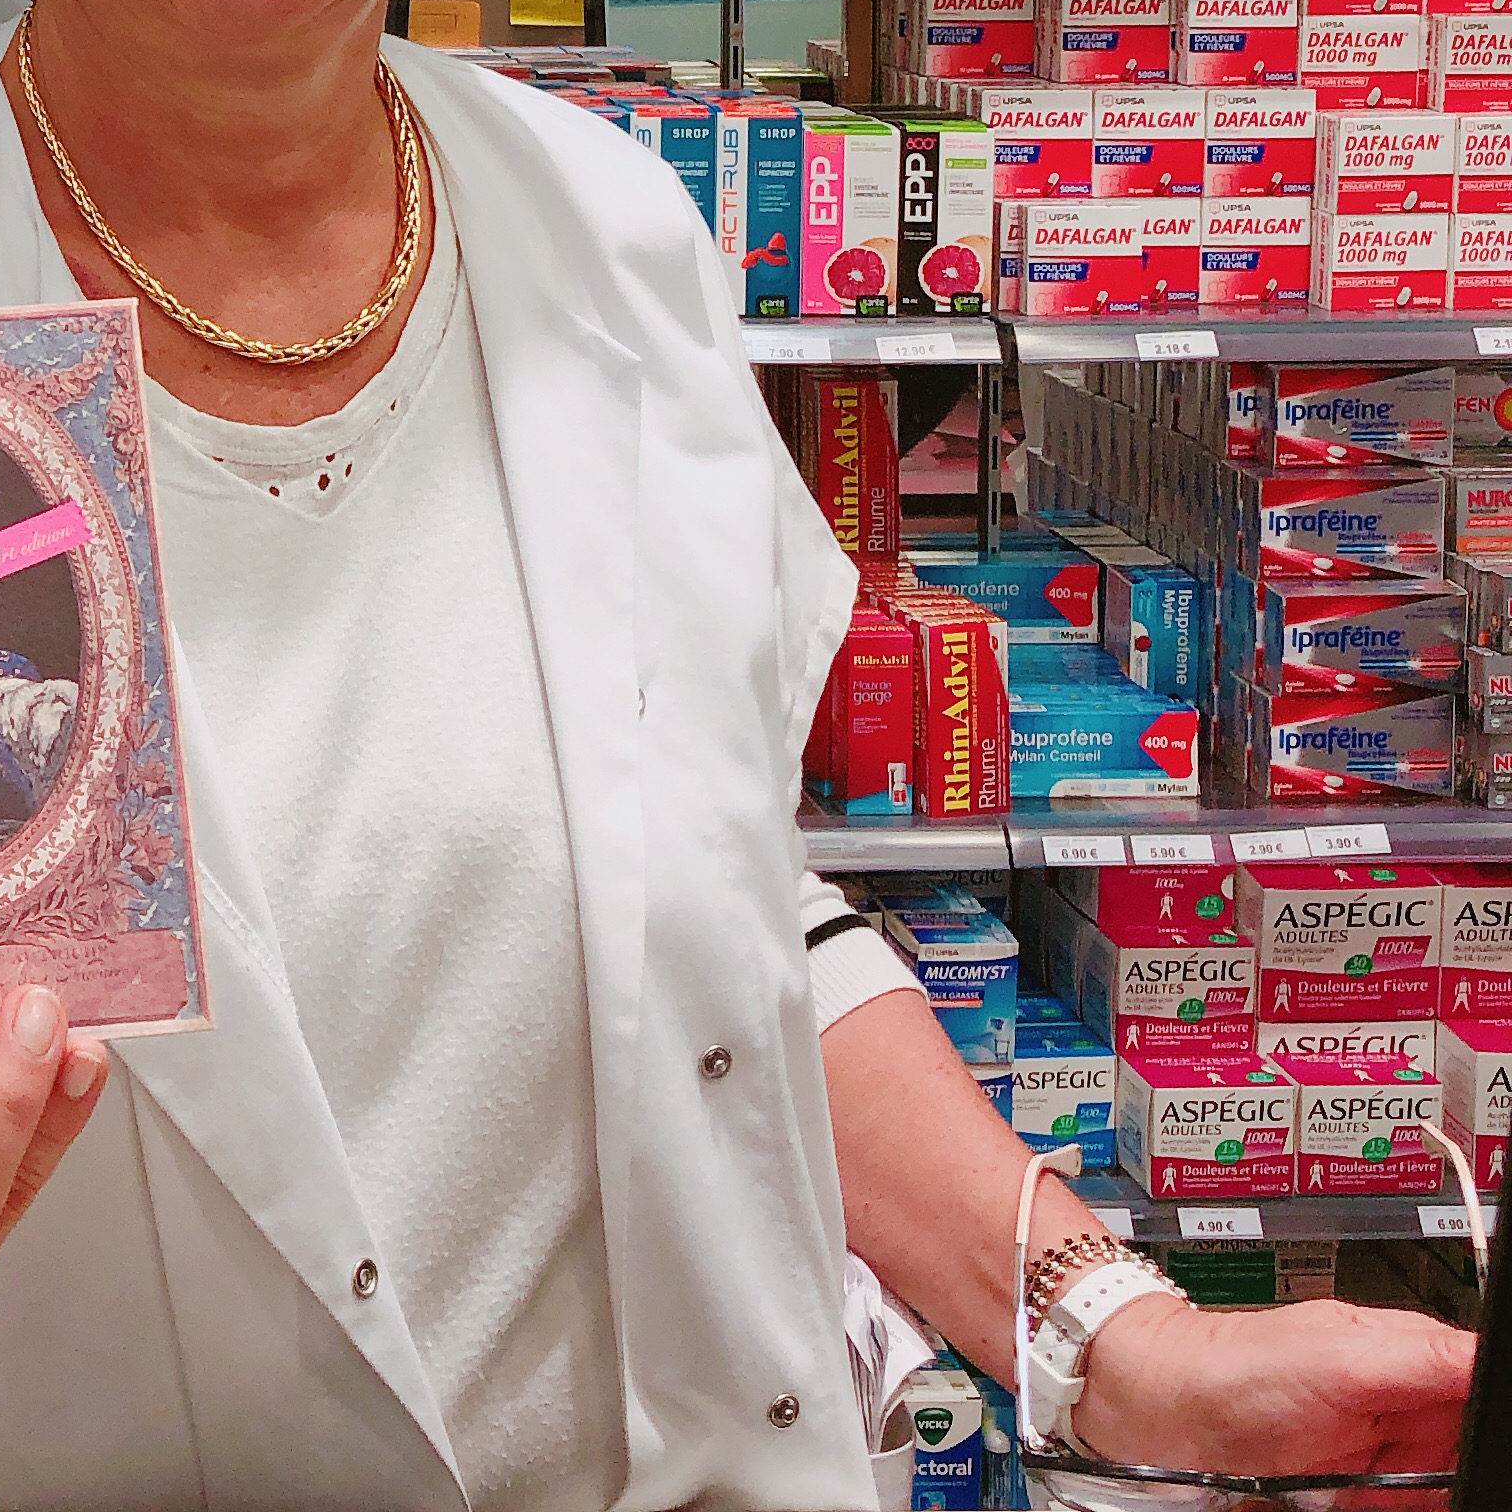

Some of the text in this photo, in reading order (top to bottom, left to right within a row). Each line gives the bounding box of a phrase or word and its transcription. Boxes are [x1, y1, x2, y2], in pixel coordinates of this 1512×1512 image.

[1196, 0, 1289, 17] DAFALGAN
[1194, 34, 1242, 44] DOULEURS
[1101, 112, 1197, 128] DAFALGAN
[809, 155, 839, 226] EPP
[1285, 399, 1389, 425] Ipraféine
[834, 387, 859, 553] RhinAdvil
[1269, 510, 1377, 536] Ipraféine
[853, 690, 892, 704] gorge
[944, 631, 971, 814] RhinAdvil
[1145, 736, 1187, 751] 400 mg
[1353, 839, 1362, 849] €
[1273, 892, 1428, 928] ASPÉGIC
[1274, 929, 1349, 944] ADULTES
[924, 965, 1009, 980] MUCOMYST
[1298, 978, 1428, 994] Douleurs et Fièvre
[1161, 1092, 1285, 1123] ASPÉGIC
[1197, 1221, 1234, 1232] 4.90 €
[917, 1420, 950, 1430] VICKS
